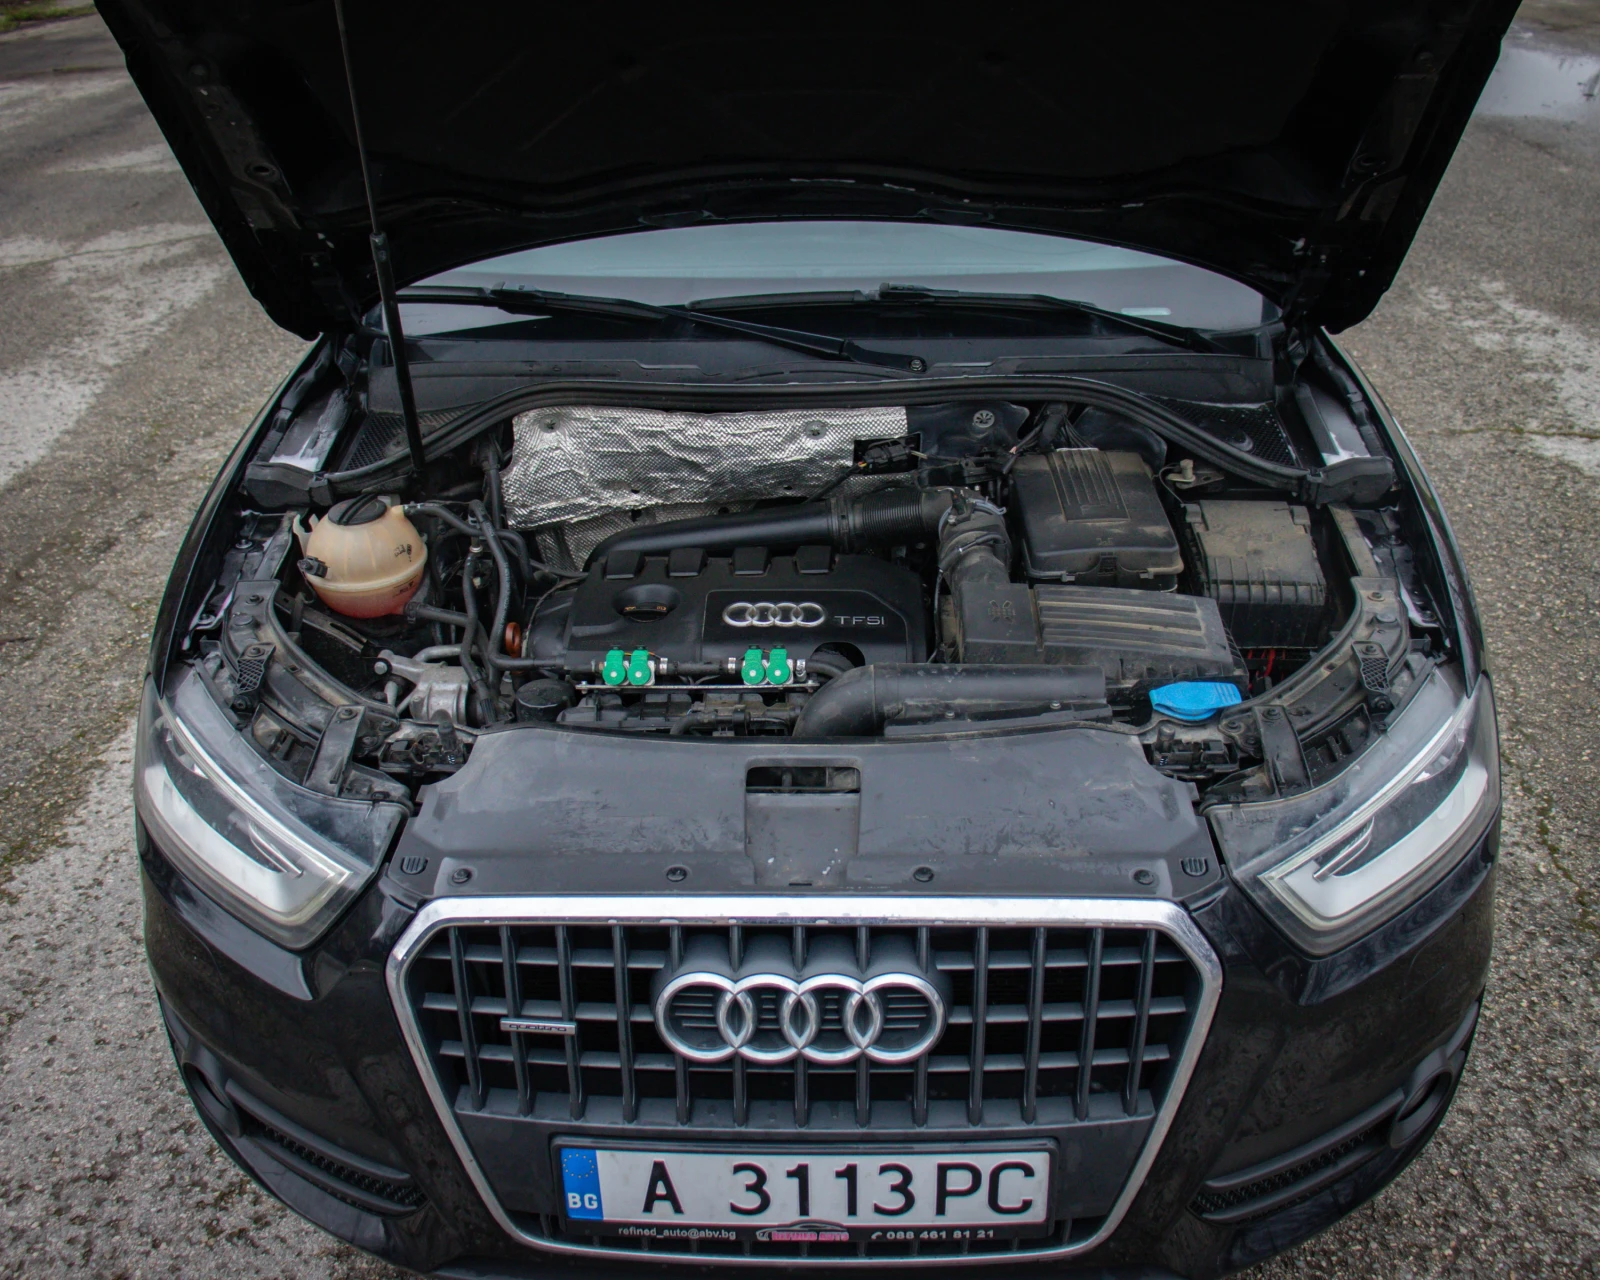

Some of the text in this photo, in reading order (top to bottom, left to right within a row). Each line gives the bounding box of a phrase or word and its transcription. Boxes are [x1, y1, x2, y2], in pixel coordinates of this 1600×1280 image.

[834, 615, 885, 626] TFSI
[509, 1023, 567, 1032] quattro
[642, 1160, 684, 1215] A
[567, 1192, 598, 1210] BG
[618, 1227, 737, 1240] refined_auto@abv.bg
[886, 1230, 995, 1240] 088 461 81 21
